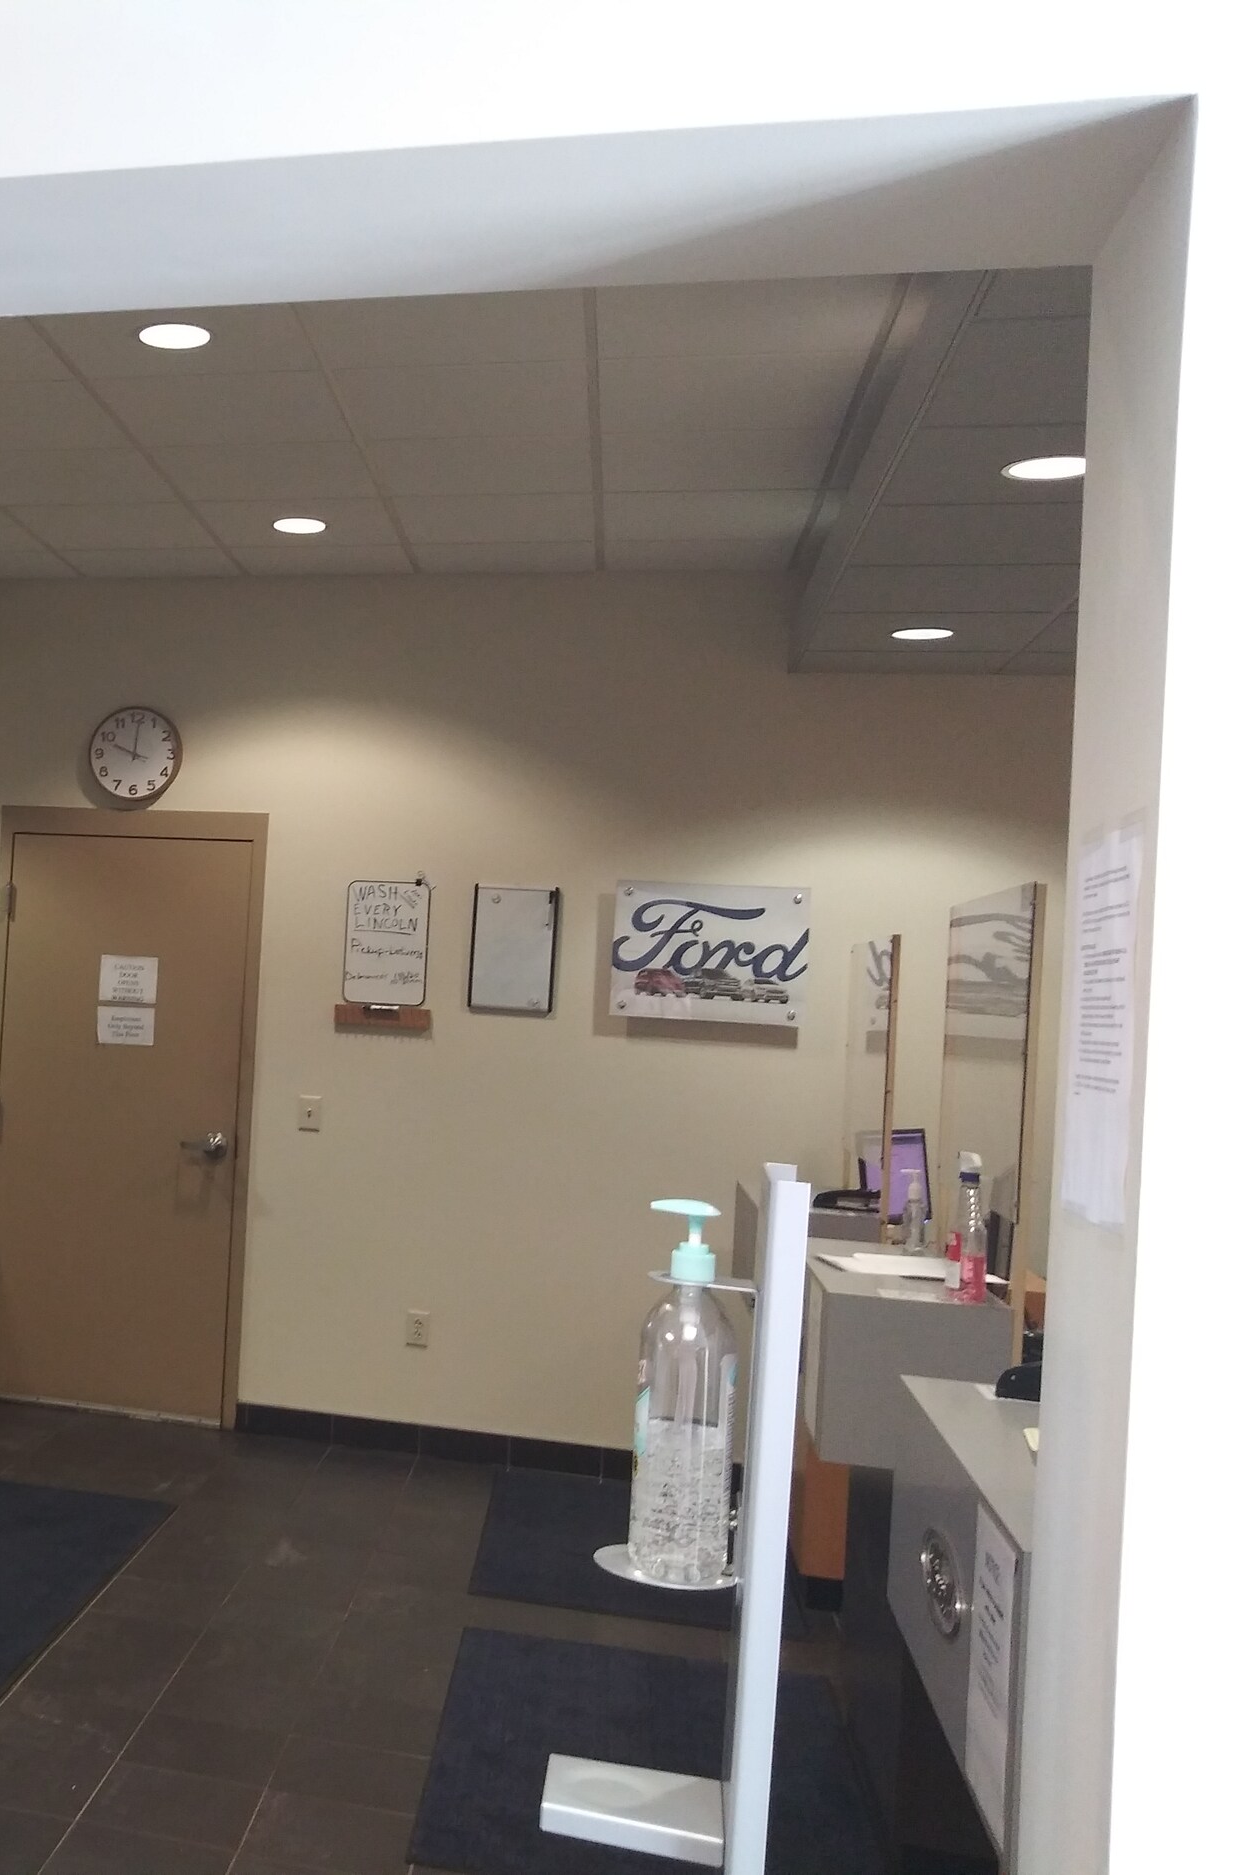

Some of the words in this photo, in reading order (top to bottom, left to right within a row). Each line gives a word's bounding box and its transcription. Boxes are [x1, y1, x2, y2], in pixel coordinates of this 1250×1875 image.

[115, 718, 126, 729] 11
[131, 712, 145, 724] 12
[151, 717, 158, 729] 1
[101, 731, 116, 743] 10
[162, 730, 171, 742] 2
[94, 748, 104, 760] 9
[166, 748, 175, 761] 3
[99, 766, 109, 778] 8
[160, 766, 169, 778] 4
[113, 779, 122, 791] 7
[129, 784, 138, 796] 6
[146, 780, 156, 792] 5
[353, 884, 398, 902] WASH
[354, 902, 403, 917] EVERY
[354, 916, 419, 932] LINCOLN
[611, 898, 811, 983] Ford
